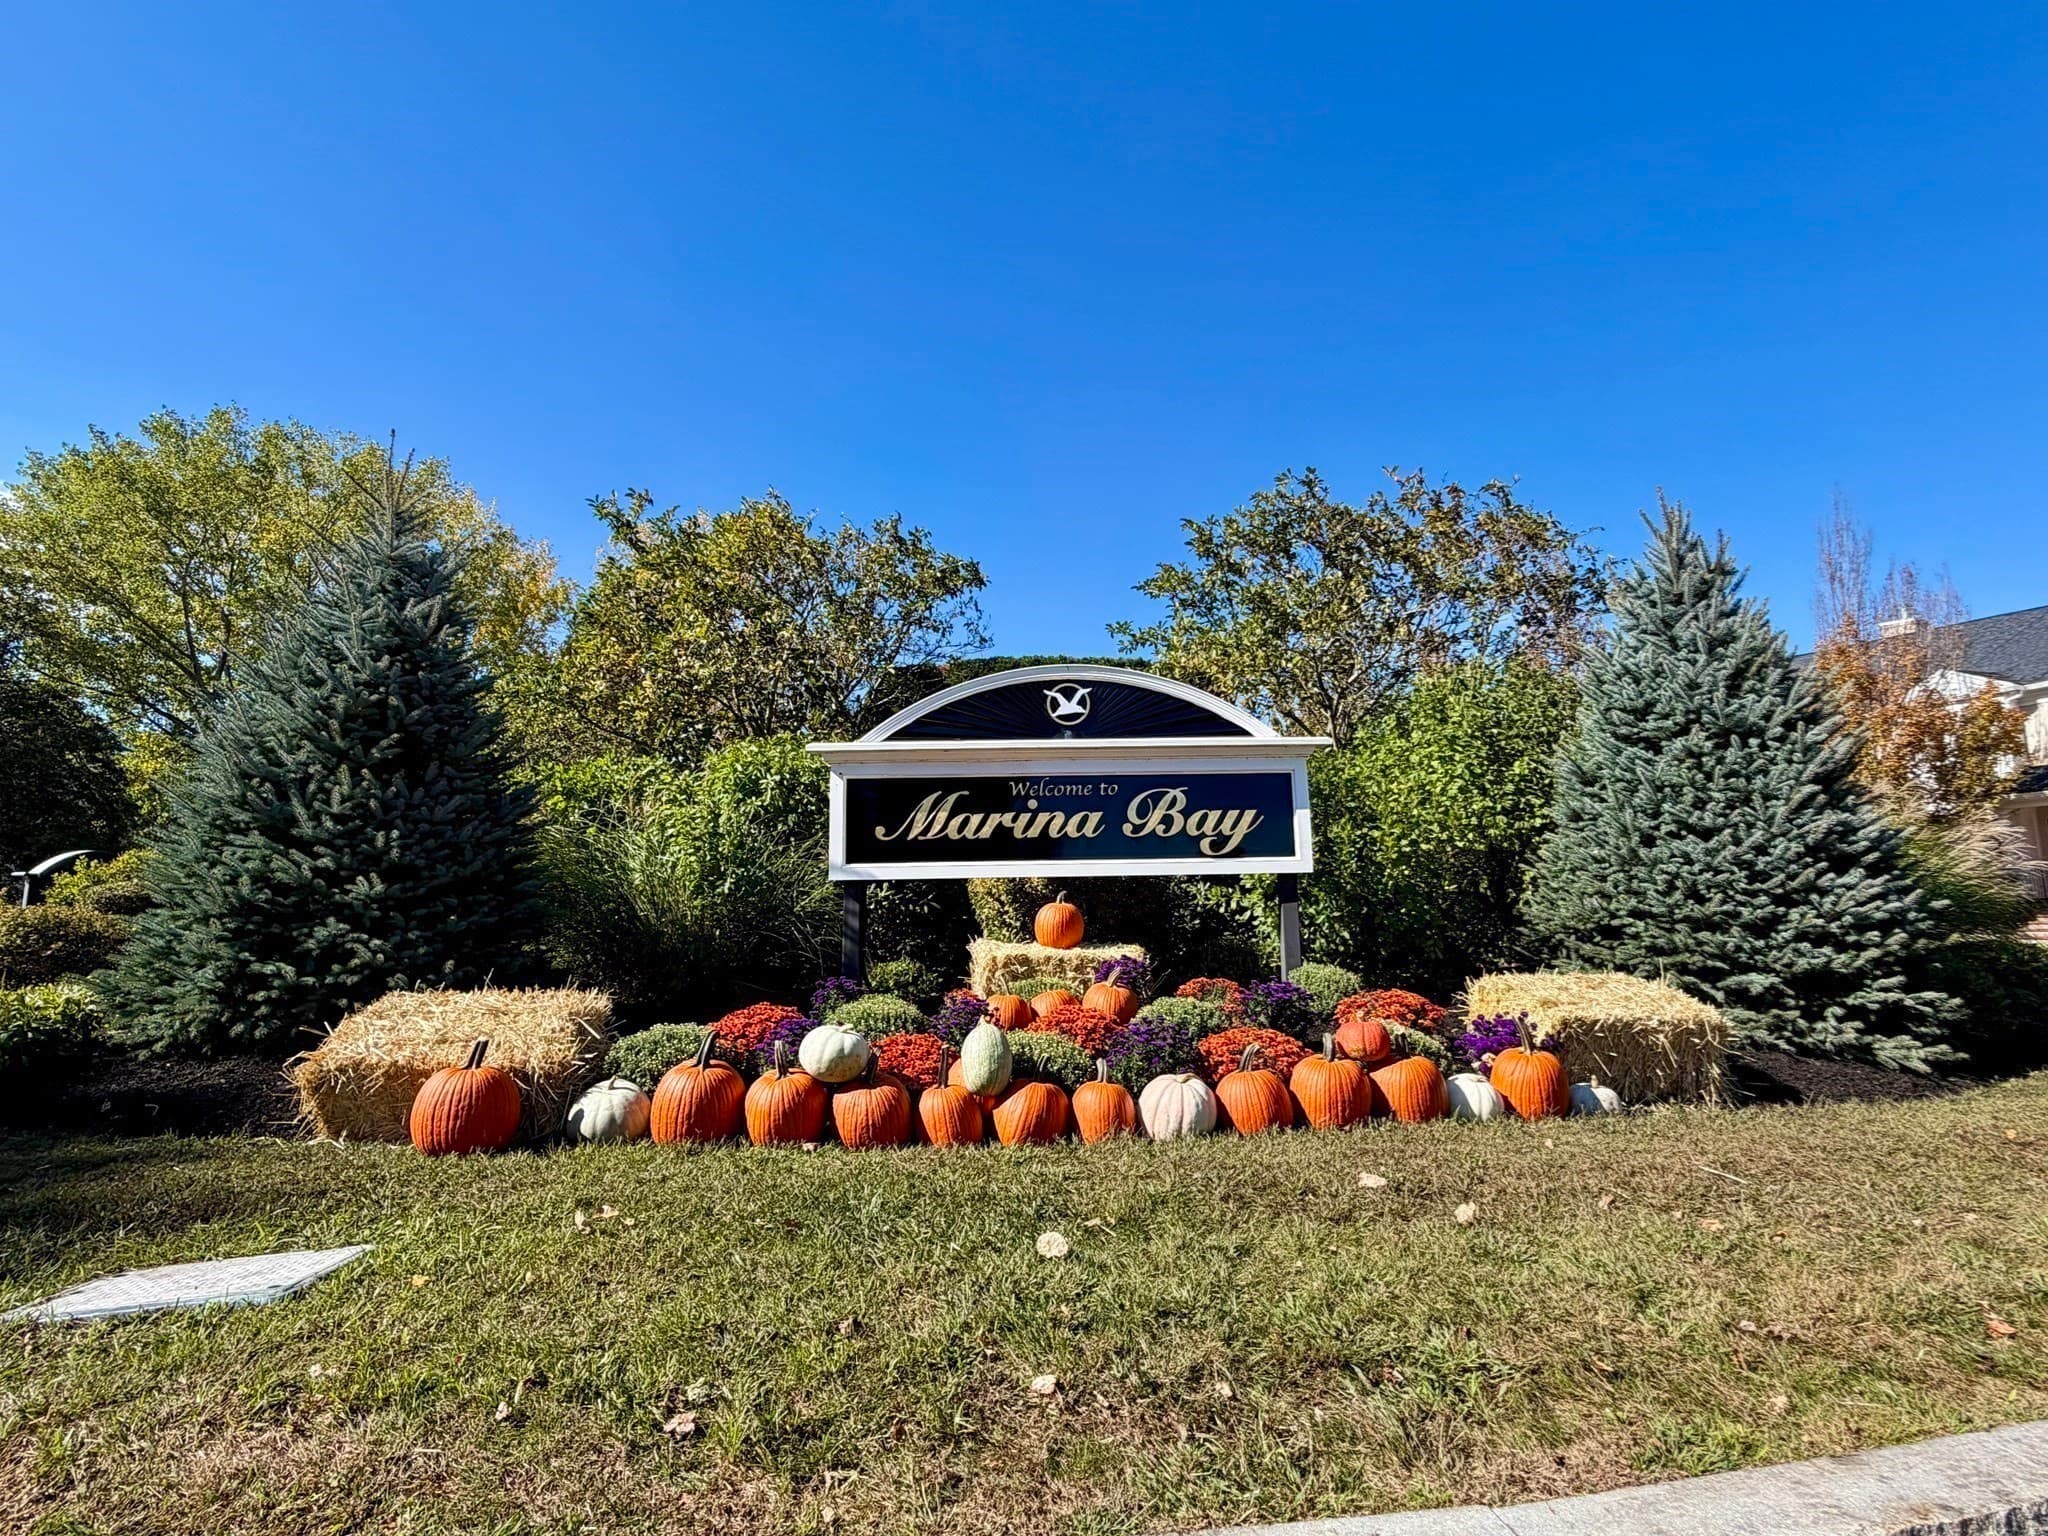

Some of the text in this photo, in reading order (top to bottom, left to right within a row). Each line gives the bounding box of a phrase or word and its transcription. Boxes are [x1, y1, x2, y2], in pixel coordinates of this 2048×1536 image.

[1008, 777, 1118, 797] Welcome to
[874, 787, 1264, 856] Marina Bay
